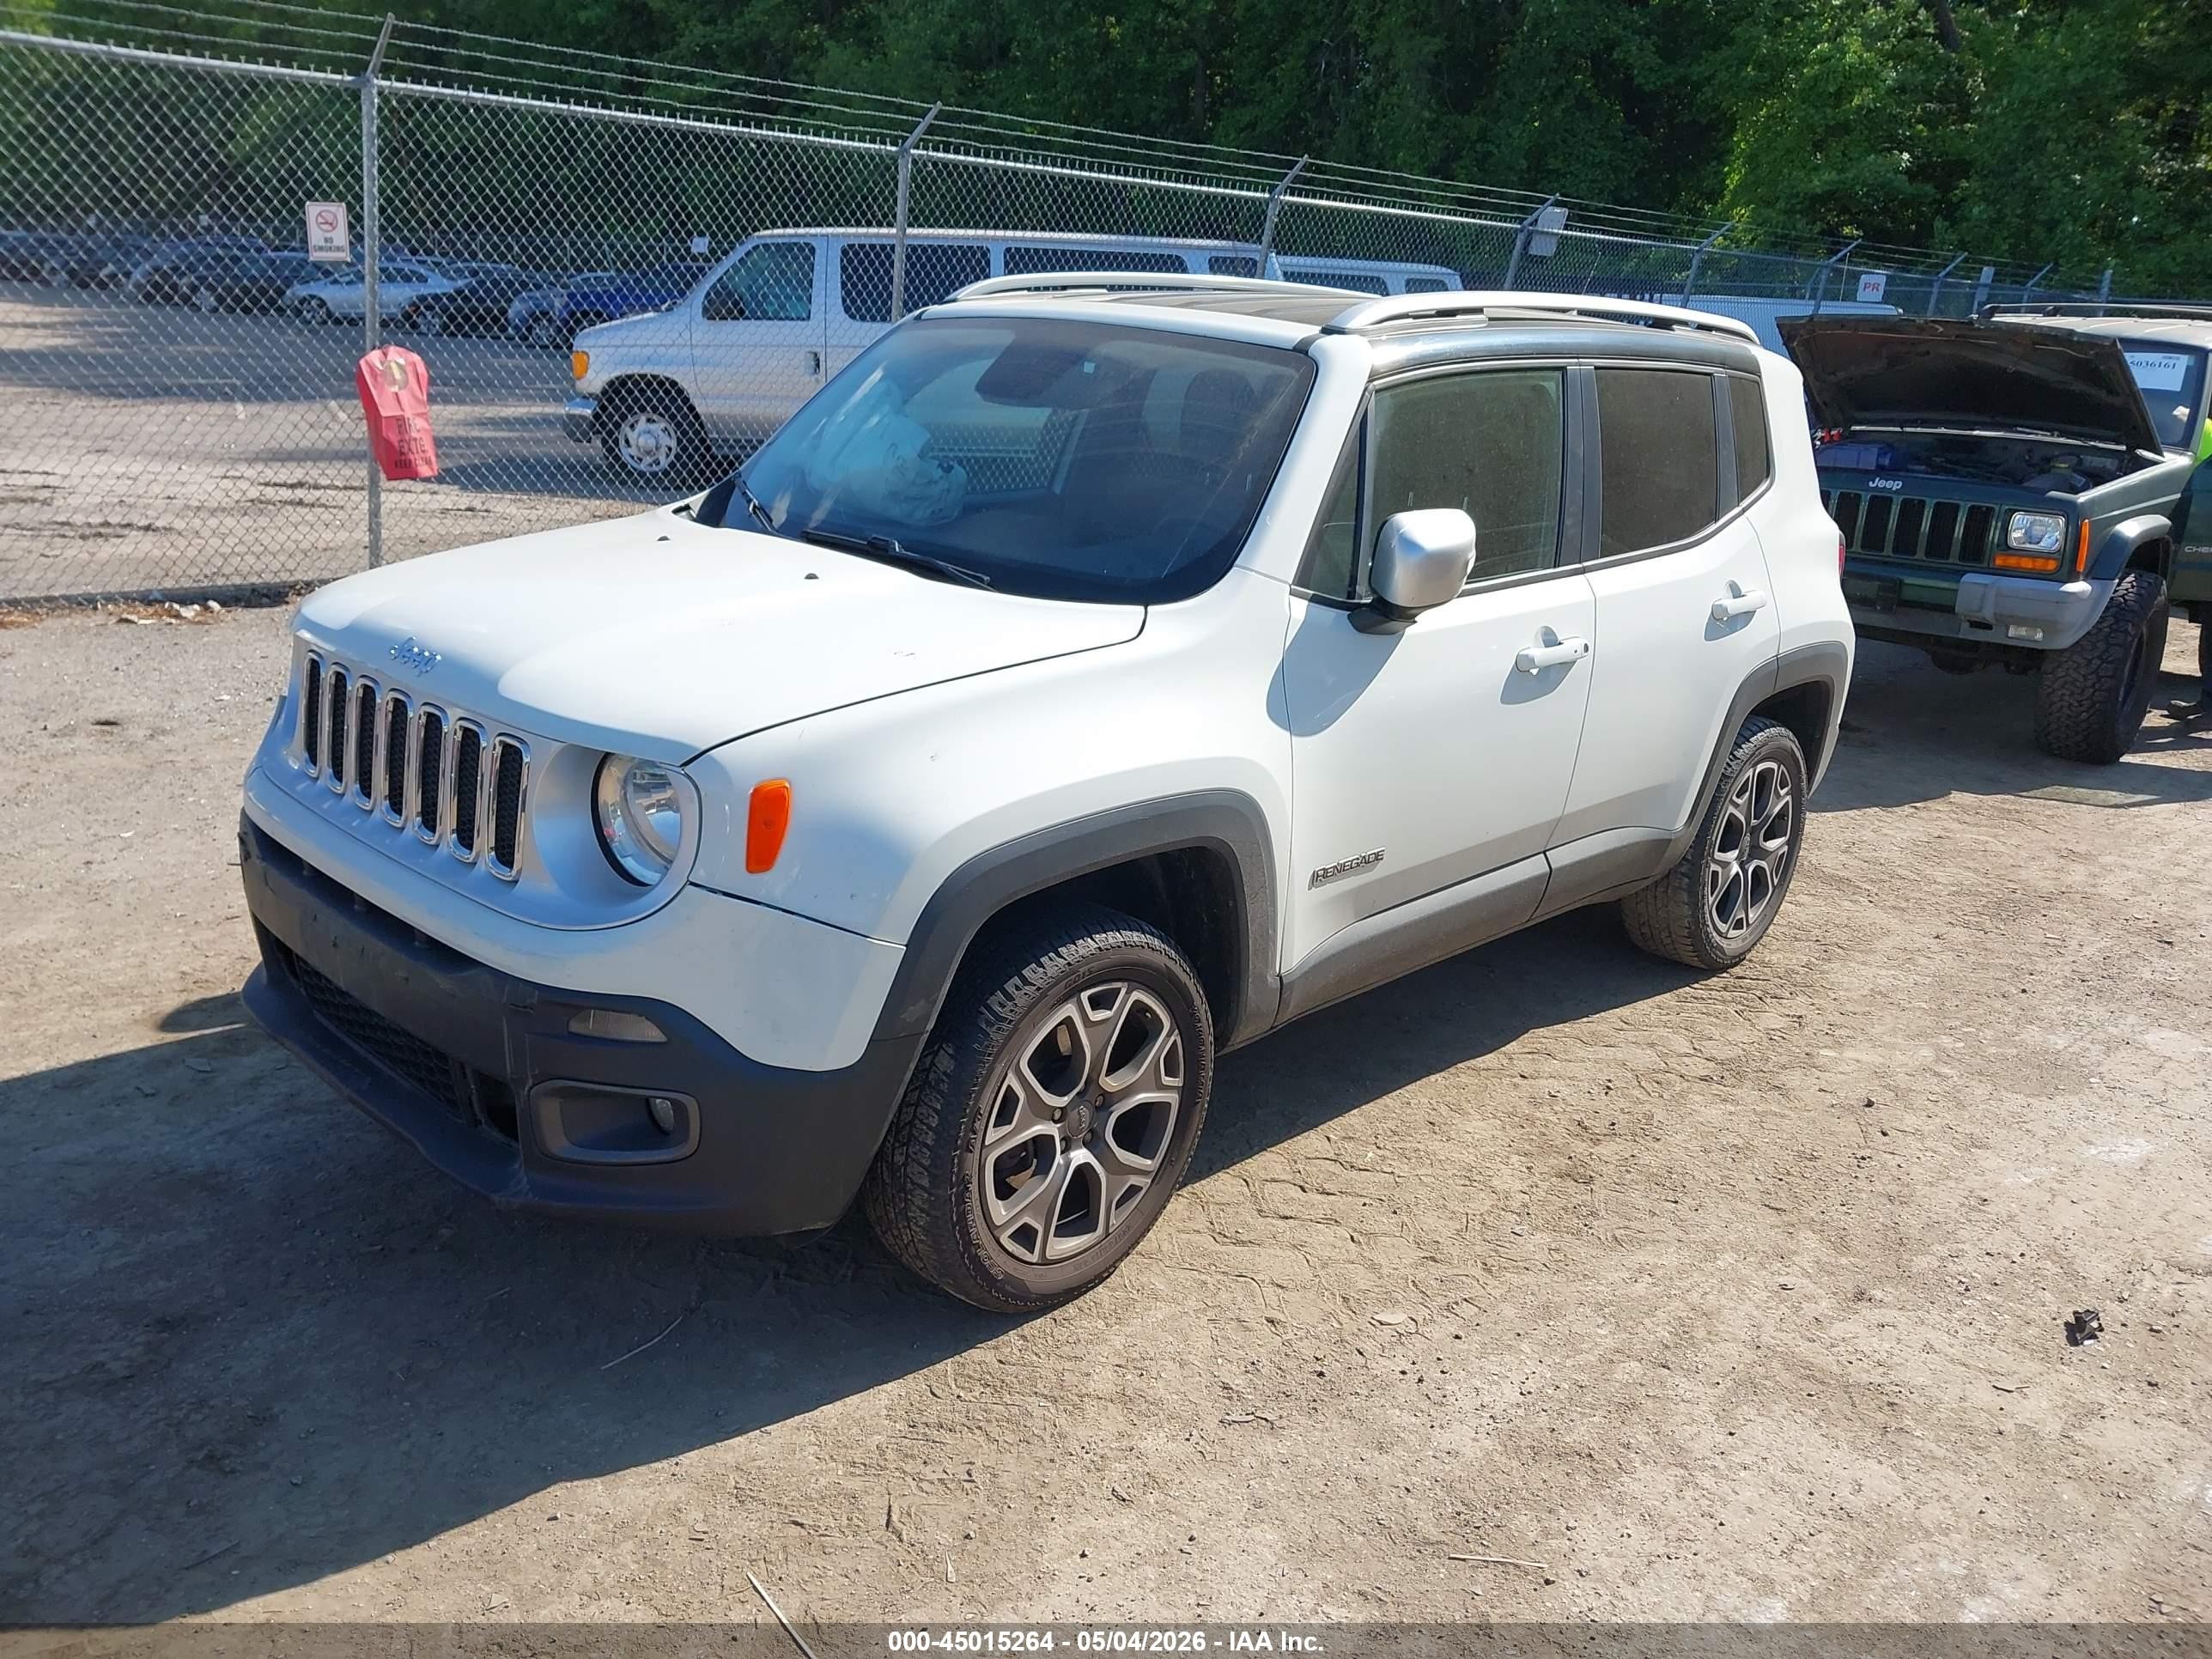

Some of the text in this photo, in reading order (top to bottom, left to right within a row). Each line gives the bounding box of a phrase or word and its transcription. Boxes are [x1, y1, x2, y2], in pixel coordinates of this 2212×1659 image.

[1869, 477, 1903, 490] Jeep
[390, 635, 442, 678] Jeep
[1311, 848, 1385, 886] RENEGADE
